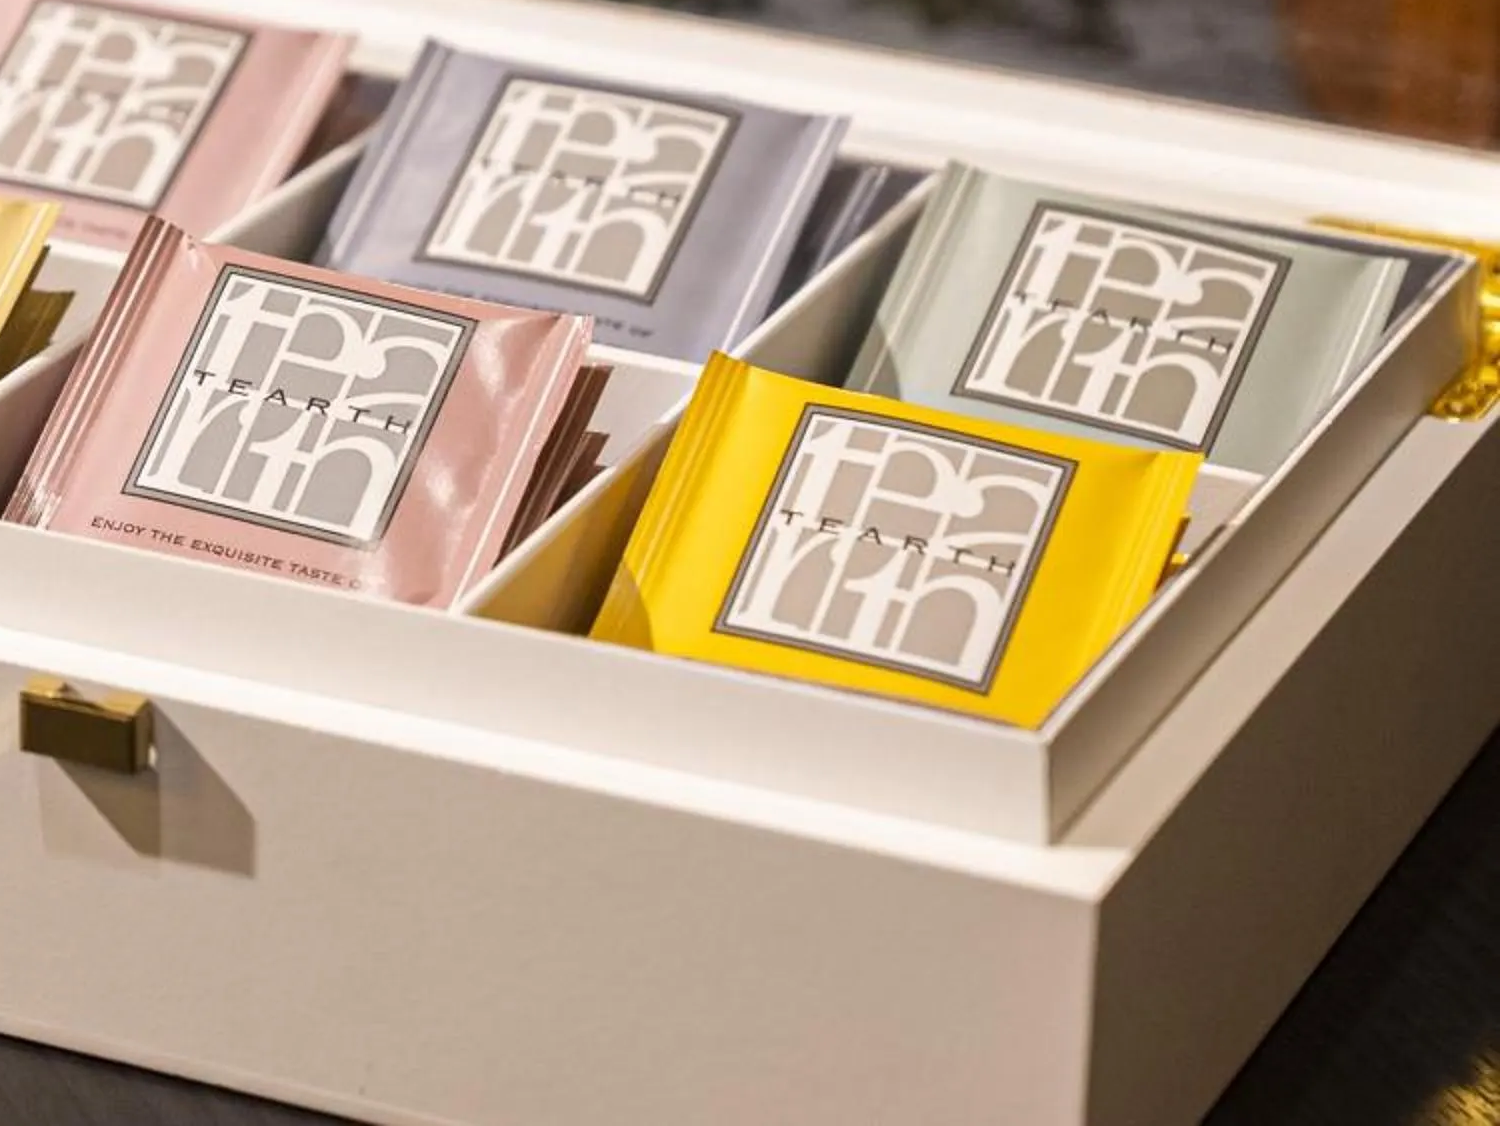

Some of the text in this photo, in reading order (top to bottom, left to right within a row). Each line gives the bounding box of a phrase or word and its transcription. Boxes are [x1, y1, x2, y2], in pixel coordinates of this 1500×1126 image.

[193, 368, 413, 436] TEARTH
[90, 516, 146, 537] ENJOY
[152, 528, 185, 547] THE
[190, 539, 284, 571] EXQUISITE
[289, 563, 344, 585] TASTE
[780, 508, 1017, 578] TEARTH
